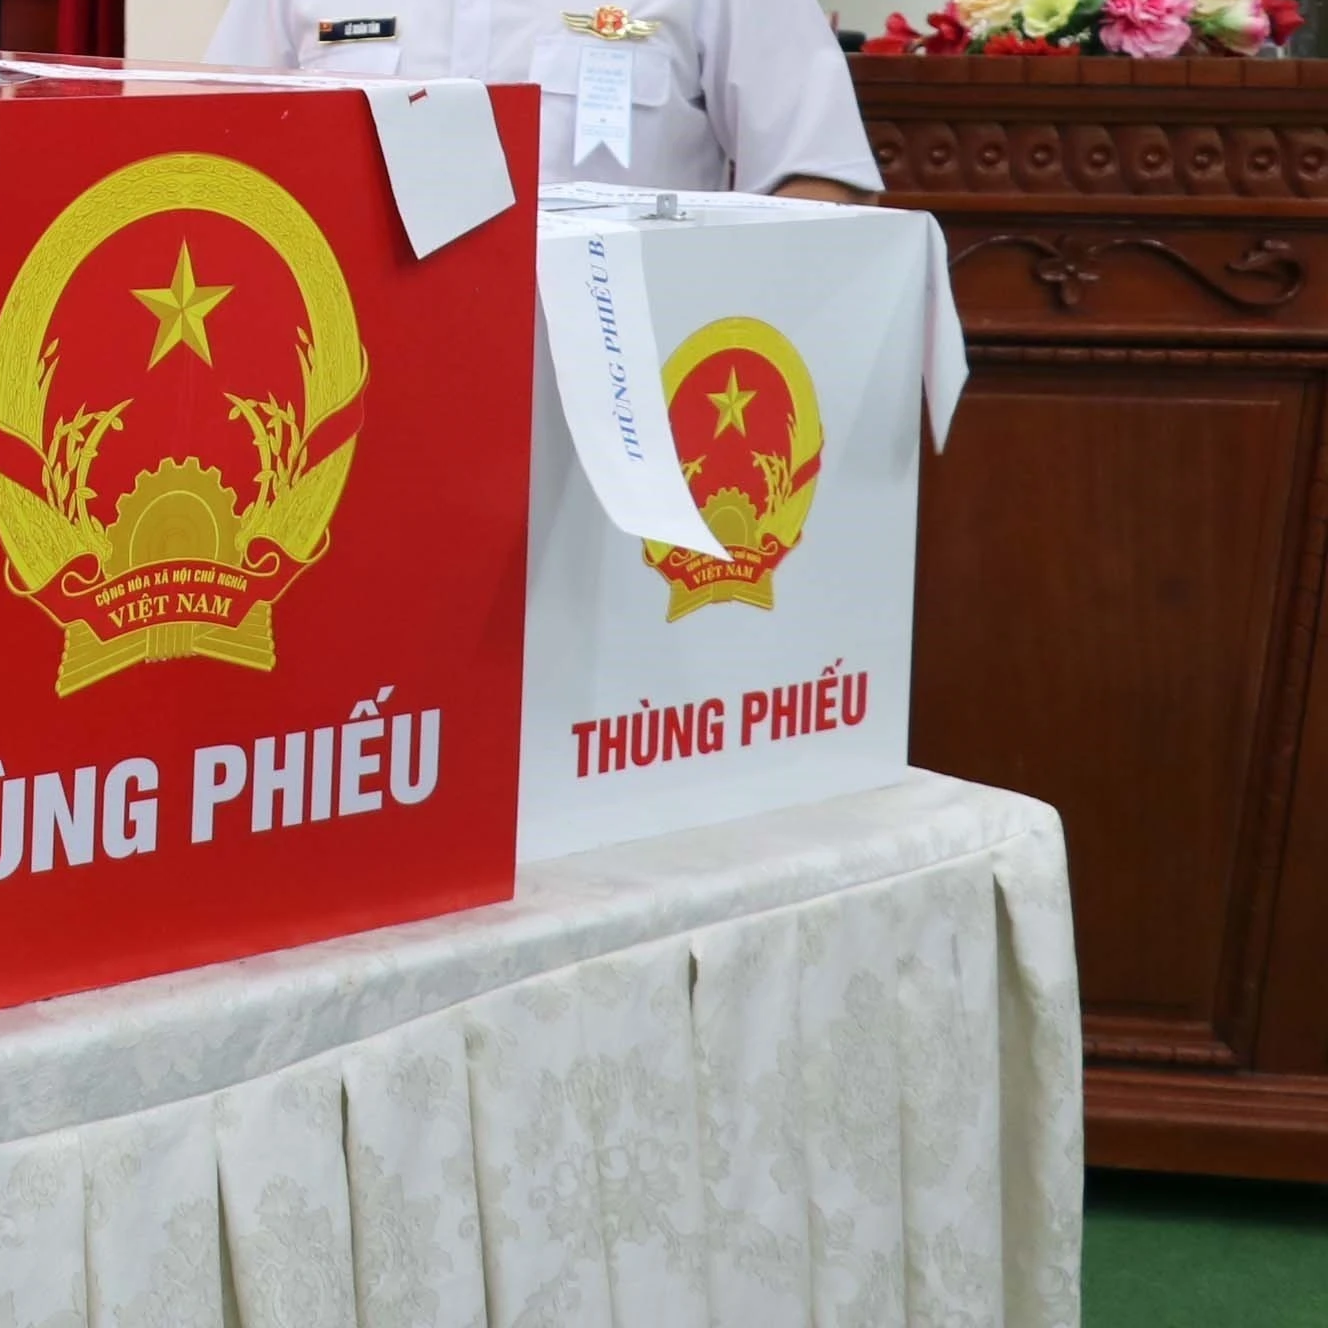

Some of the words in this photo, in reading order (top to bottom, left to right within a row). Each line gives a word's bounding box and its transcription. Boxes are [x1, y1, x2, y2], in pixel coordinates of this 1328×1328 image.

[585, 264, 622, 354] PHIẾU
[608, 362, 643, 462] THÙNG
[95, 586, 125, 607] CỘNG
[172, 567, 191, 584] HỘI
[194, 567, 216, 584] CHỦ
[108, 593, 169, 628] VIỆT
[175, 592, 233, 618] NAM
[191, 685, 441, 844] PHIẾU
[571, 698, 725, 778] THÙNG
[741, 658, 868, 748] PHIẾU
